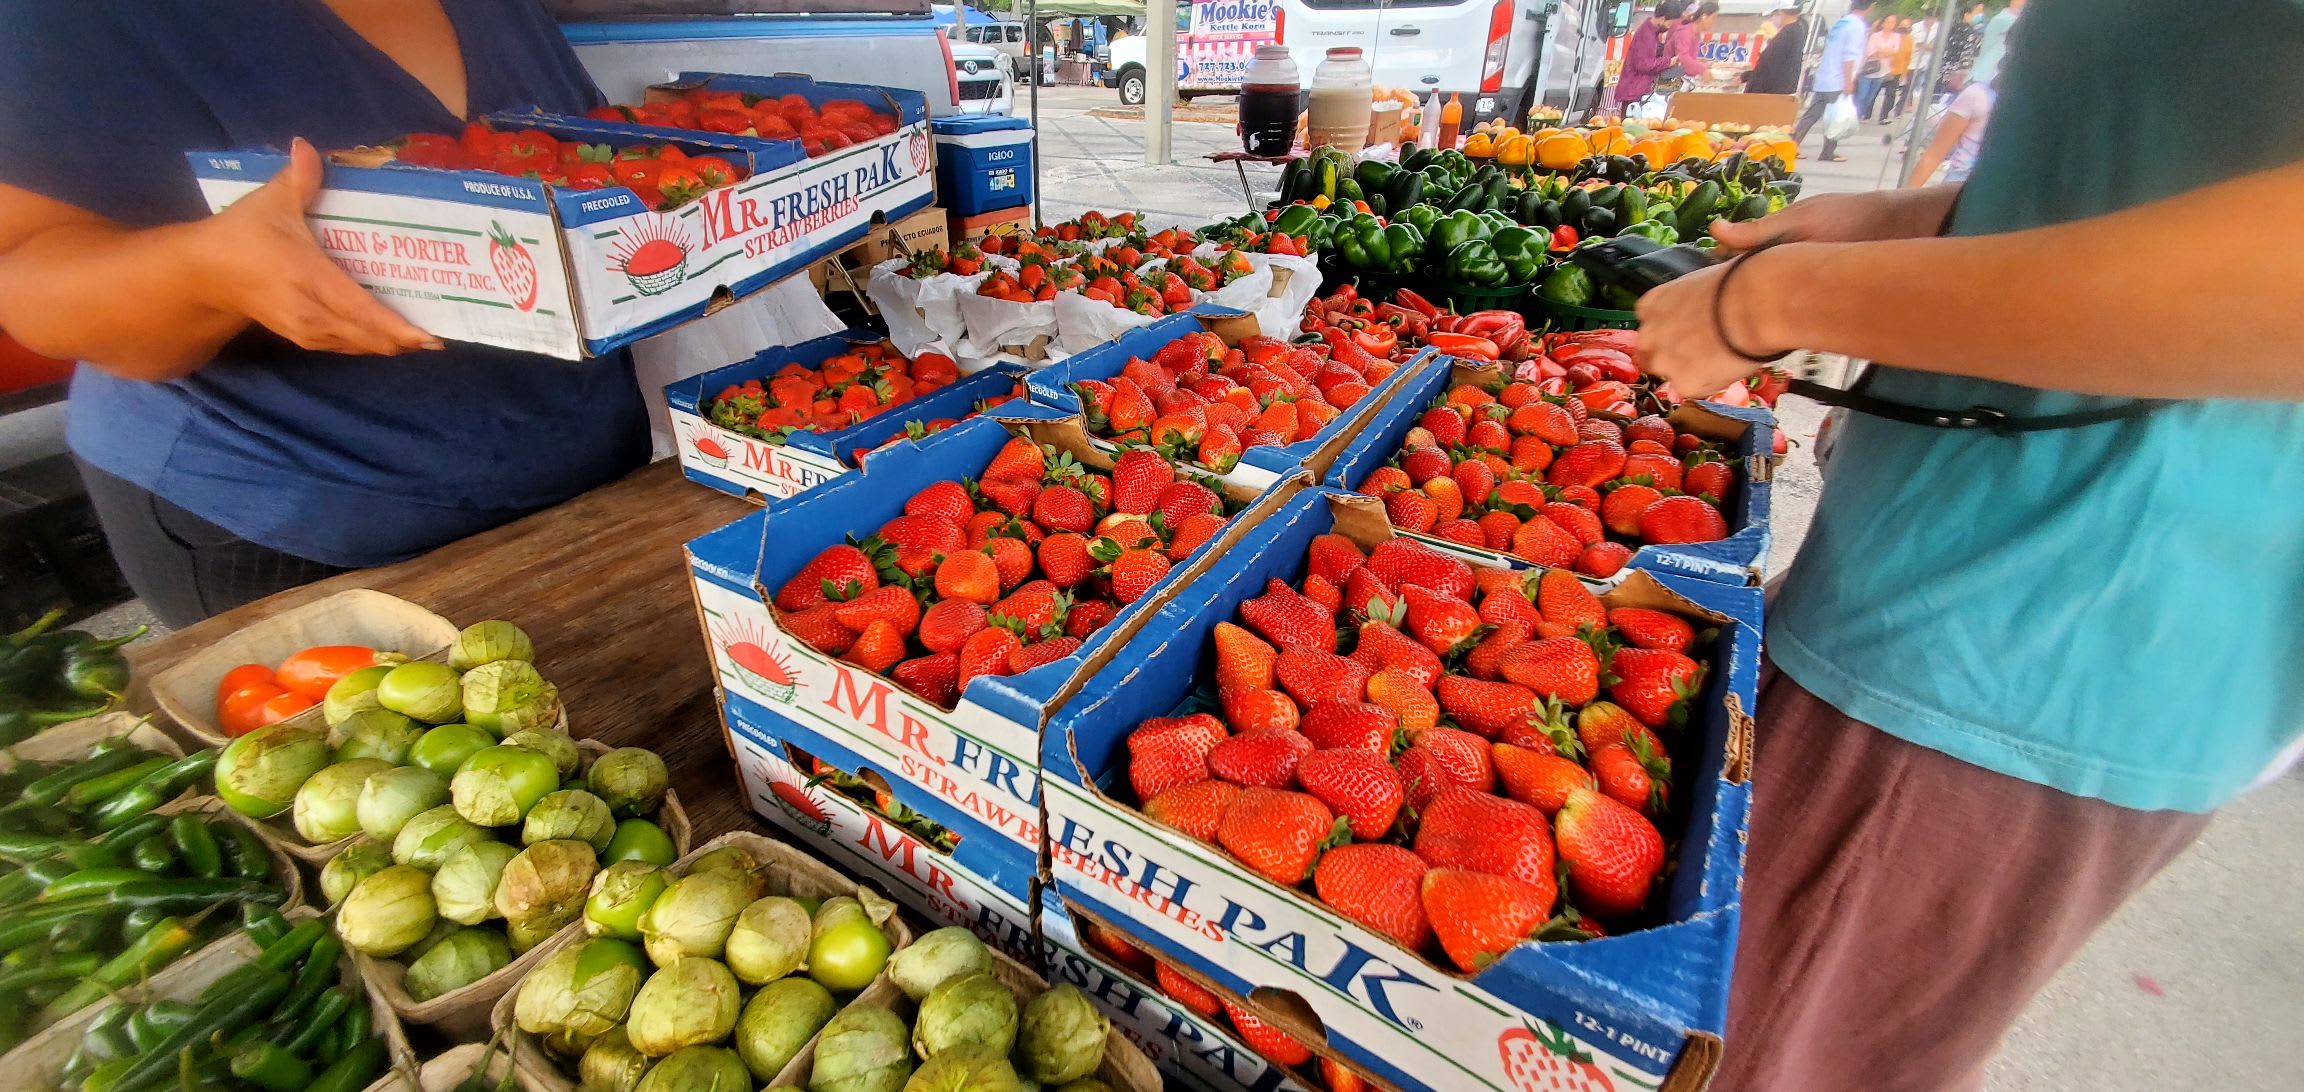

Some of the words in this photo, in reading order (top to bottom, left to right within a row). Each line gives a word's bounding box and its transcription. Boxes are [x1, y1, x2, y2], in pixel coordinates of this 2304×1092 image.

[1199, 0, 1278, 24] Mookie's
[1209, 23, 1238, 32] Kettle
[1241, 22, 1266, 31] Korn
[1199, 62, 1245, 71] 727.723.0
[988, 149, 1014, 162] IGLOO
[463, 180, 501, 196] PRODUCE
[501, 185, 511, 198] OF
[512, 186, 536, 201] U.S.A.
[769, 171, 850, 231] FRESH
[854, 140, 901, 195] PAK
[581, 194, 631, 213] PRECOOLED
[743, 194, 860, 259] STRAWBERRIES
[917, 225, 944, 238] ECUADOR
[323, 228, 368, 254] AKIN
[372, 231, 388, 256] &
[390, 234, 472, 266] PORTER
[371, 261, 387, 278] OF
[388, 263, 430, 283] PLANT
[431, 268, 468, 290] CITY,
[468, 272, 497, 292] INC.
[374, 285, 396, 296] PLANT
[1681, 558, 1712, 575] PINT
[736, 718, 778, 748] PRECOOLED
[1574, 1010, 1618, 1041] 12-1
[1619, 1032, 1672, 1065] PINT
